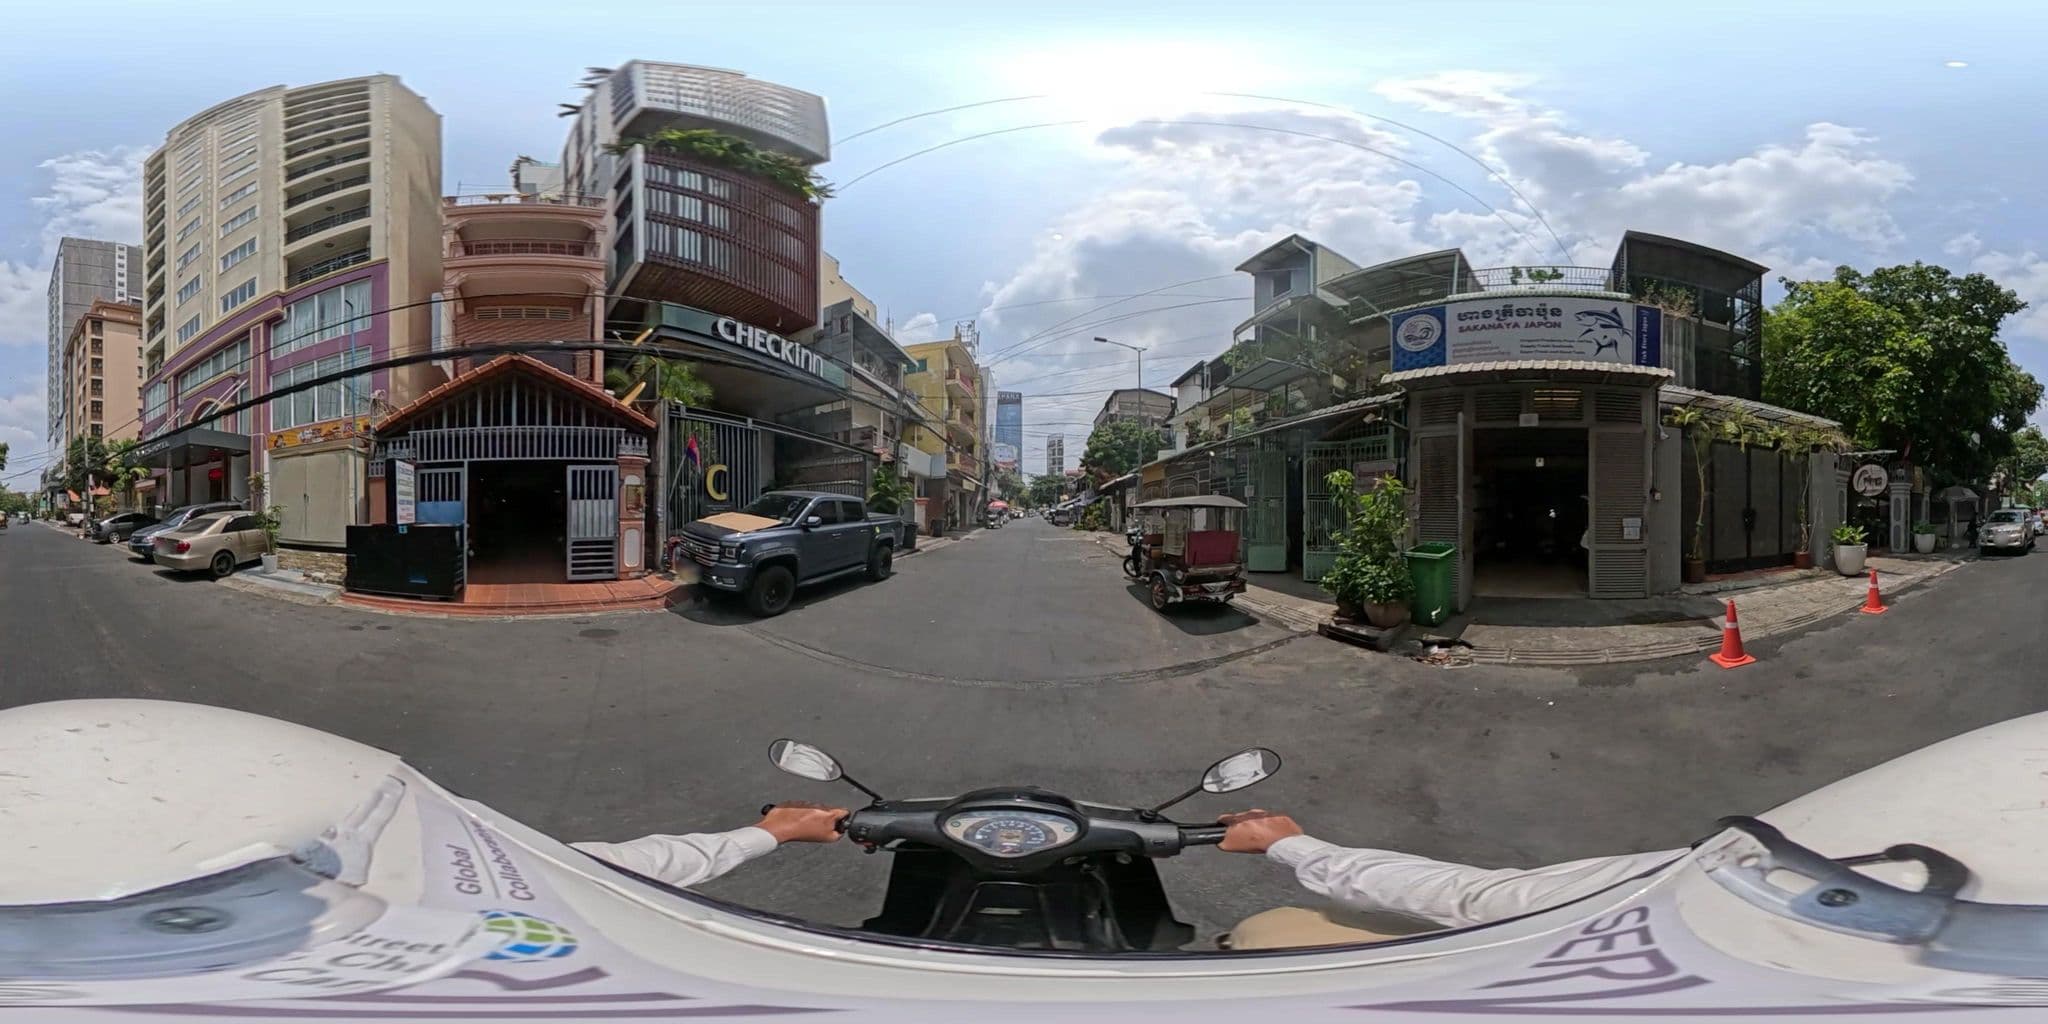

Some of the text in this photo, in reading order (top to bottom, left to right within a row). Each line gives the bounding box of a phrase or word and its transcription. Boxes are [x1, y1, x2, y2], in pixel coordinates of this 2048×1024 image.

[1458, 321, 1562, 334] SAKANAYA JAPON
[706, 464, 728, 501] C
[445, 843, 482, 895] Global
